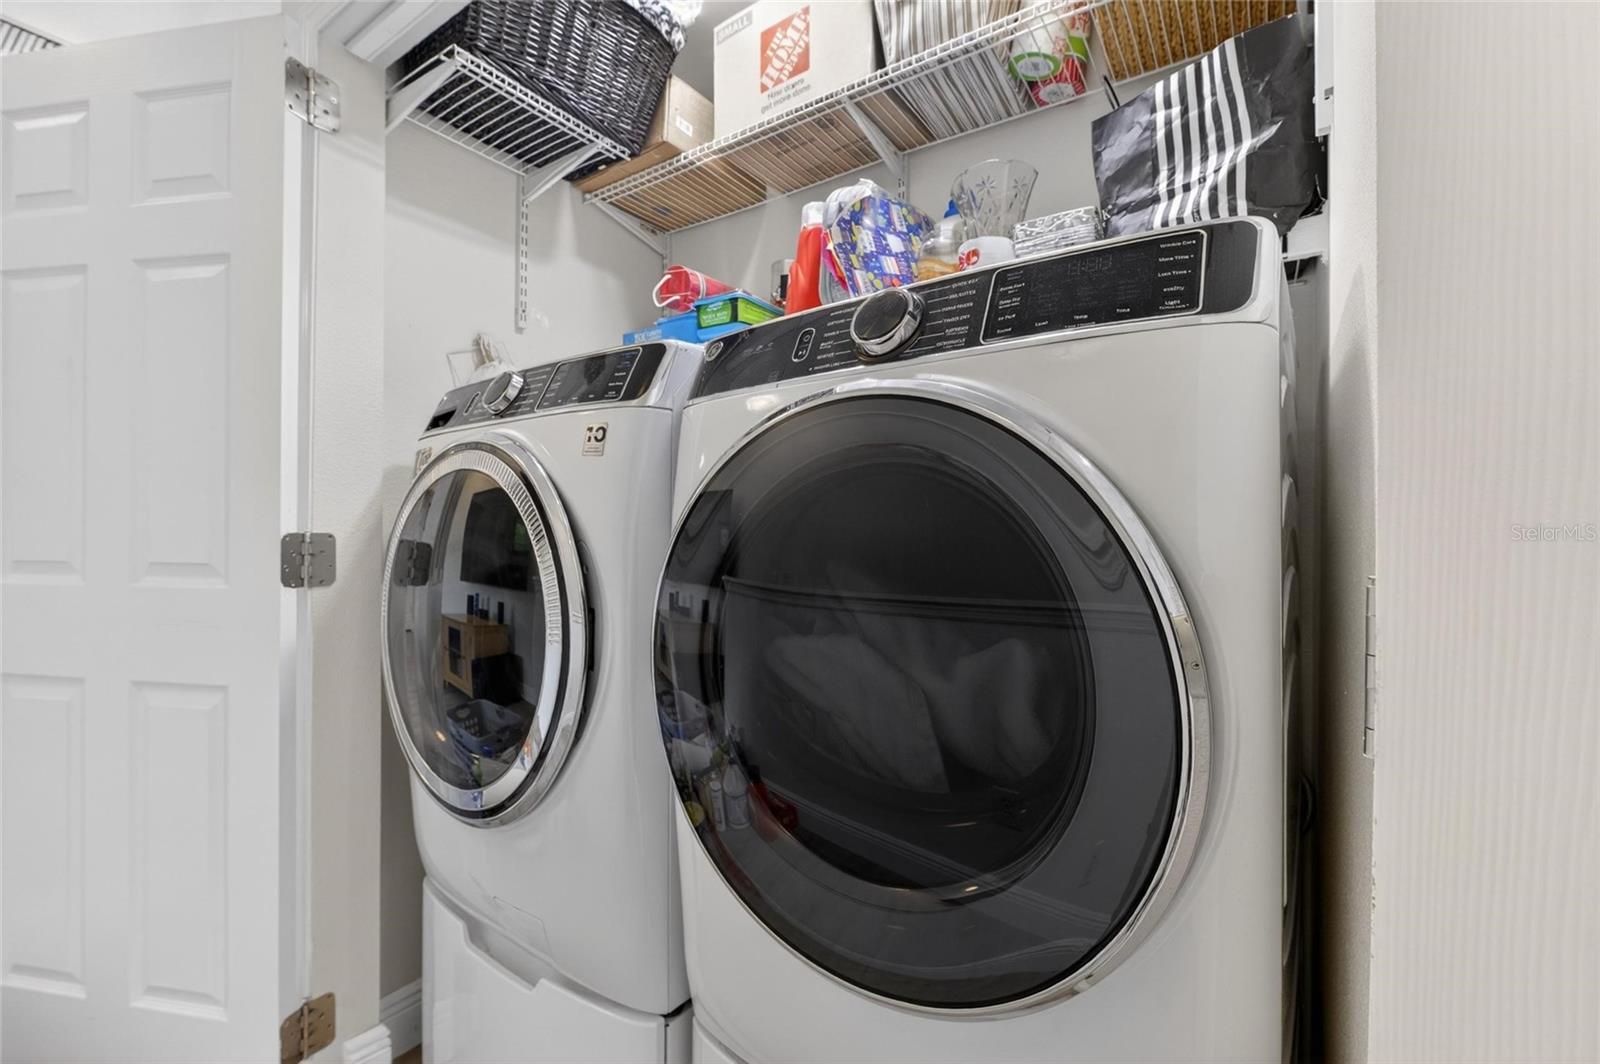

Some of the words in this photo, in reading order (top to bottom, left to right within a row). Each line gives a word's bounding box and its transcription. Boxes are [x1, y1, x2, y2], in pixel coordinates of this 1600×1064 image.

[718, 14, 750, 42] SMALL
[765, 28, 784, 58] THE
[760, 13, 810, 89] HOME
[779, 30, 810, 81] DEPOT
